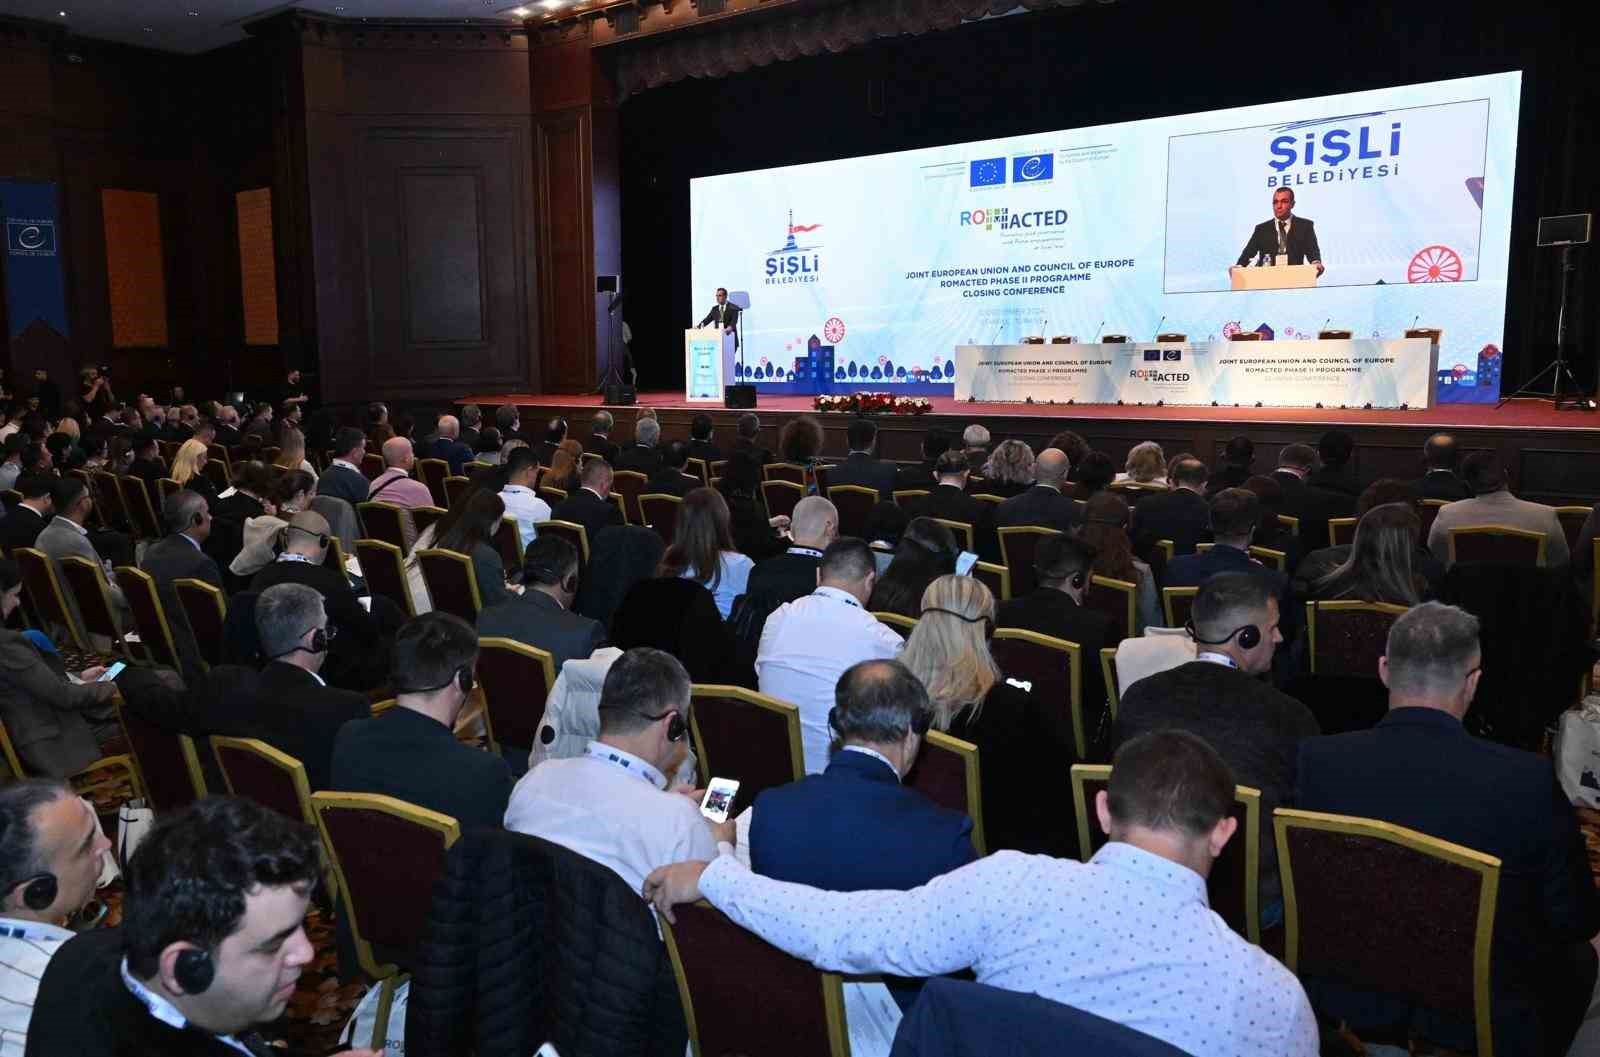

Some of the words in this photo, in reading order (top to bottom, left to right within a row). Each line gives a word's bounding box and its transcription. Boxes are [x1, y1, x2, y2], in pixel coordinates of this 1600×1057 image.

[905, 271, 930, 280] JOINT
[931, 267, 978, 278] EUROPEAN
[980, 266, 1009, 275] UNION
[1011, 264, 1031, 273] AND
[1033, 262, 1076, 272] COUNCIL
[1078, 261, 1092, 270] OF
[1094, 258, 1135, 269] EUROPE
[940, 278, 988, 288] ROMACTED
[990, 276, 1020, 285] PHASE
[1022, 276, 1028, 284] II
[1030, 273, 1091, 283] PROGRAMME
[963, 288, 1001, 298] CLOSING
[1003, 285, 1065, 296] CONFERENCE
